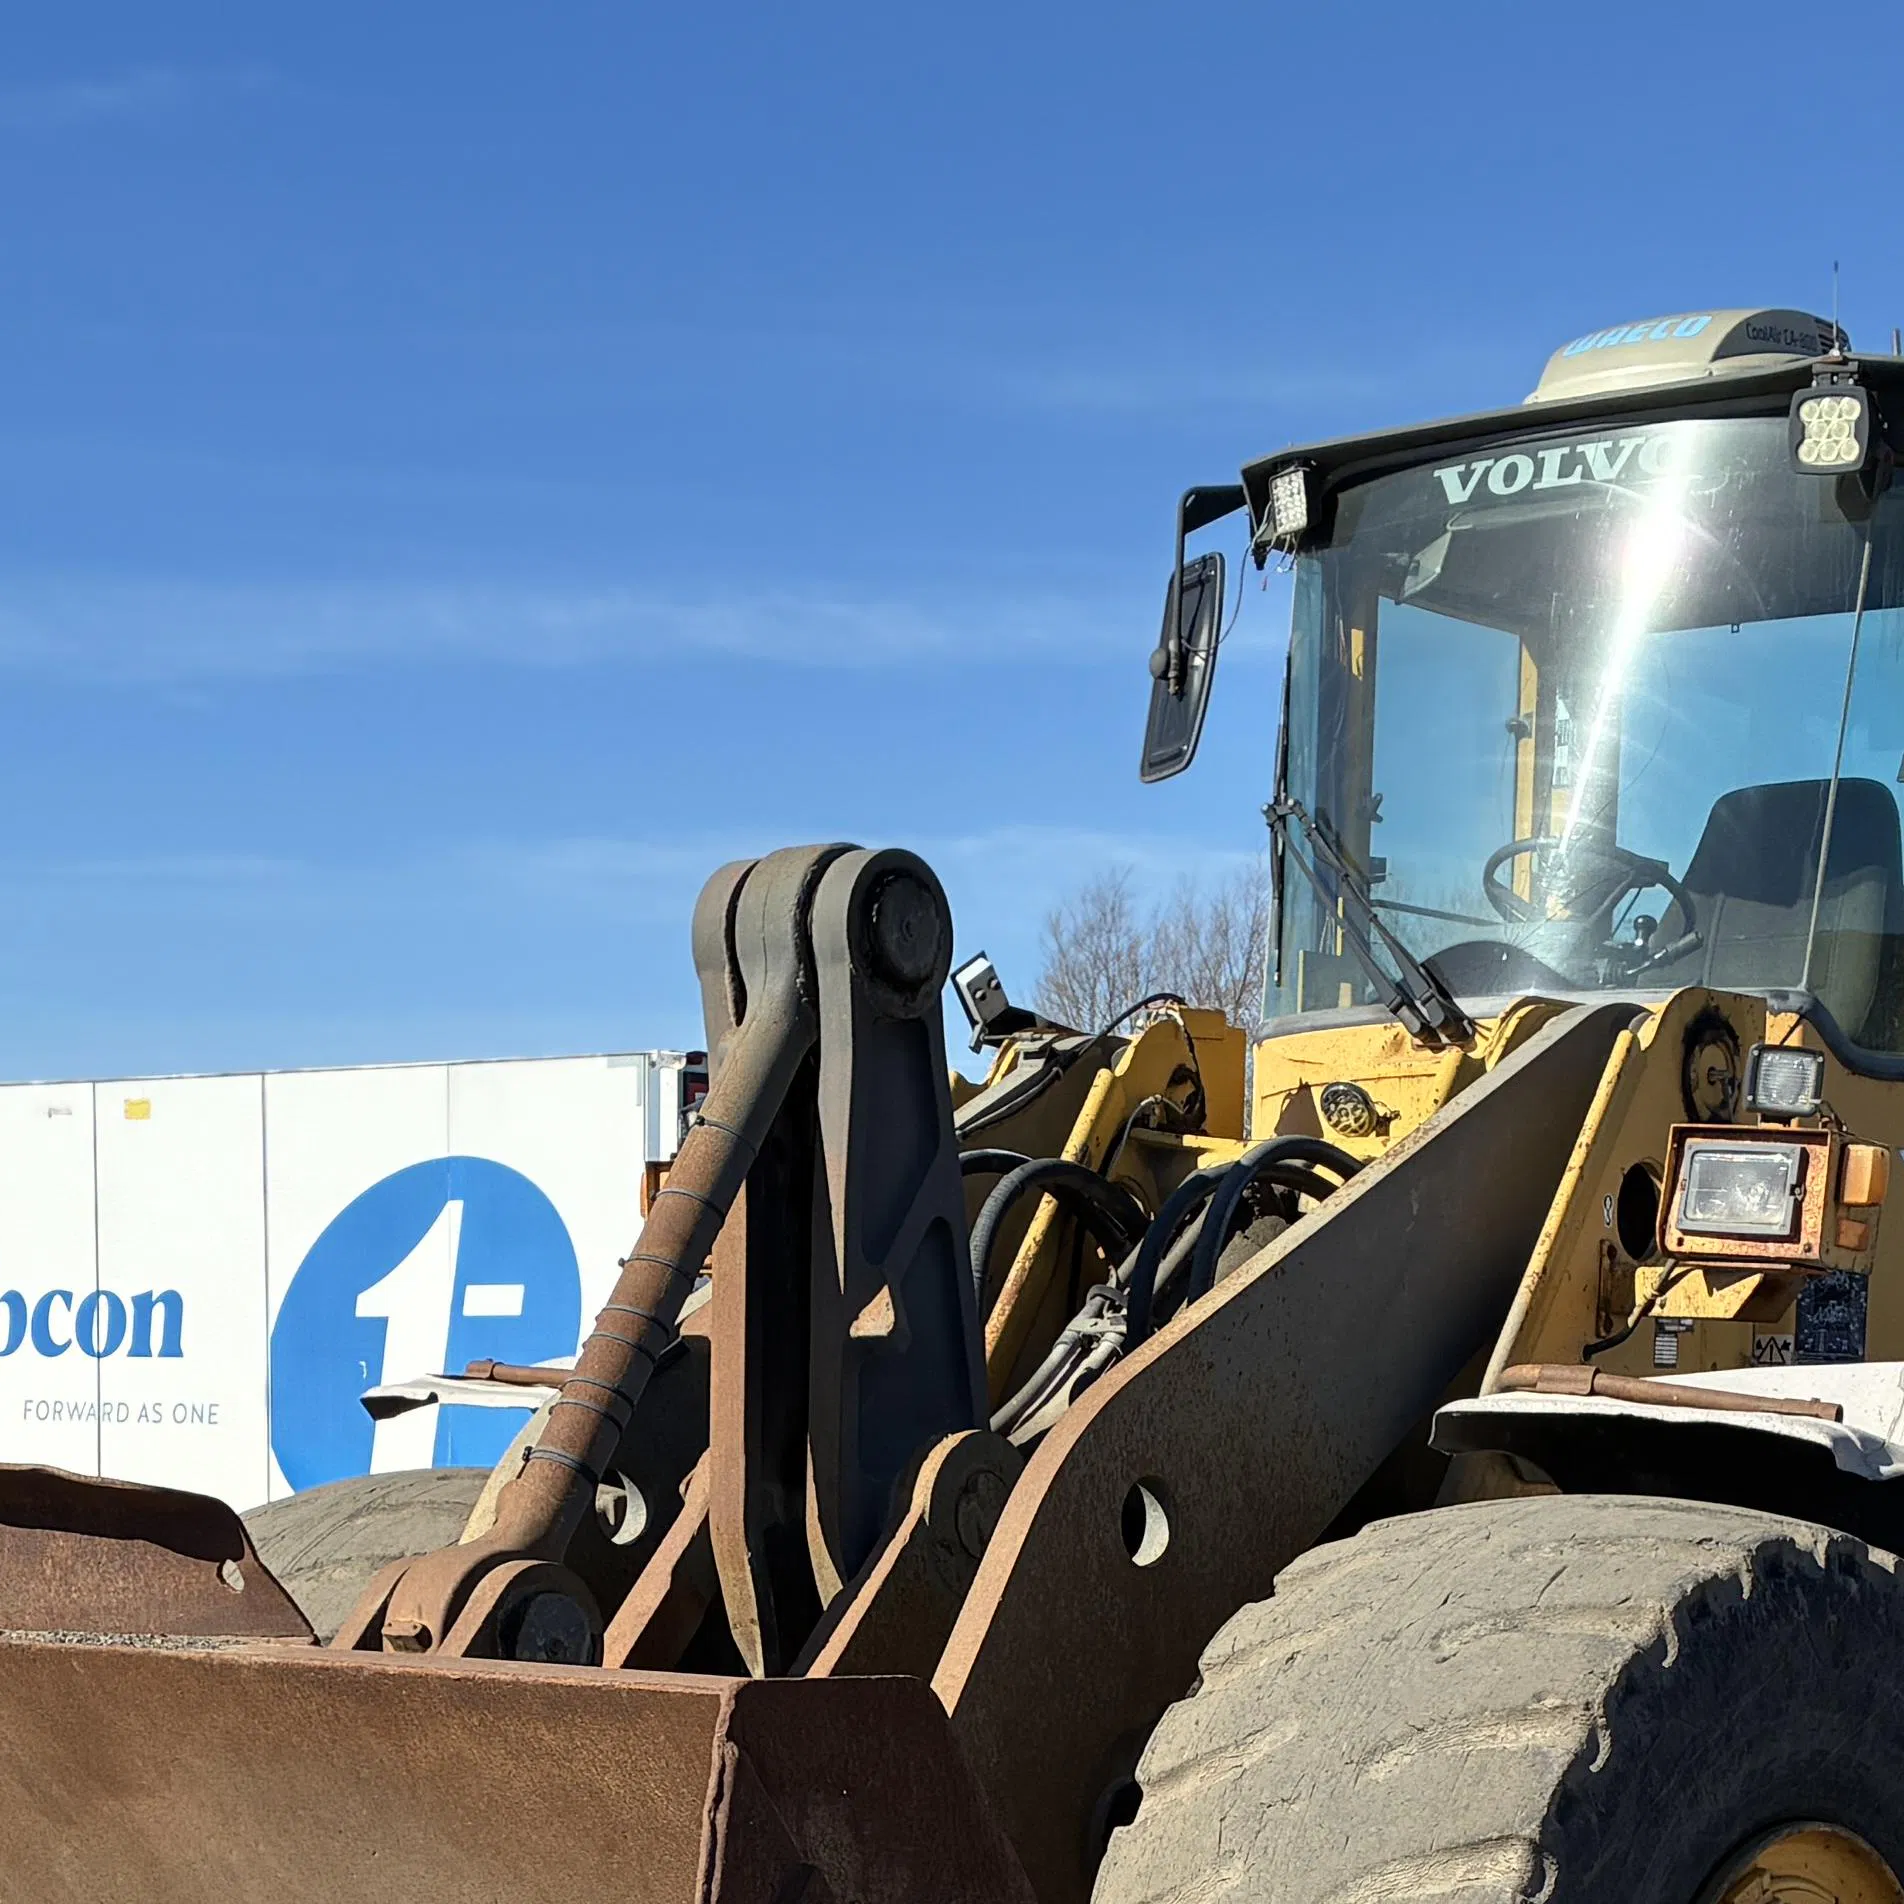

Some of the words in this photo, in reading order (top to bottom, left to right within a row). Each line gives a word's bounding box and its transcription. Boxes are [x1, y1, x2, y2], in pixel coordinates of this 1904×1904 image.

[1563, 315, 1713, 358] WAECO
[1433, 434, 1684, 505] VOLVO
[23, 1400, 129, 1424] FORWARD
[137, 1403, 162, 1424] AS
[172, 1403, 220, 1424] ONE
